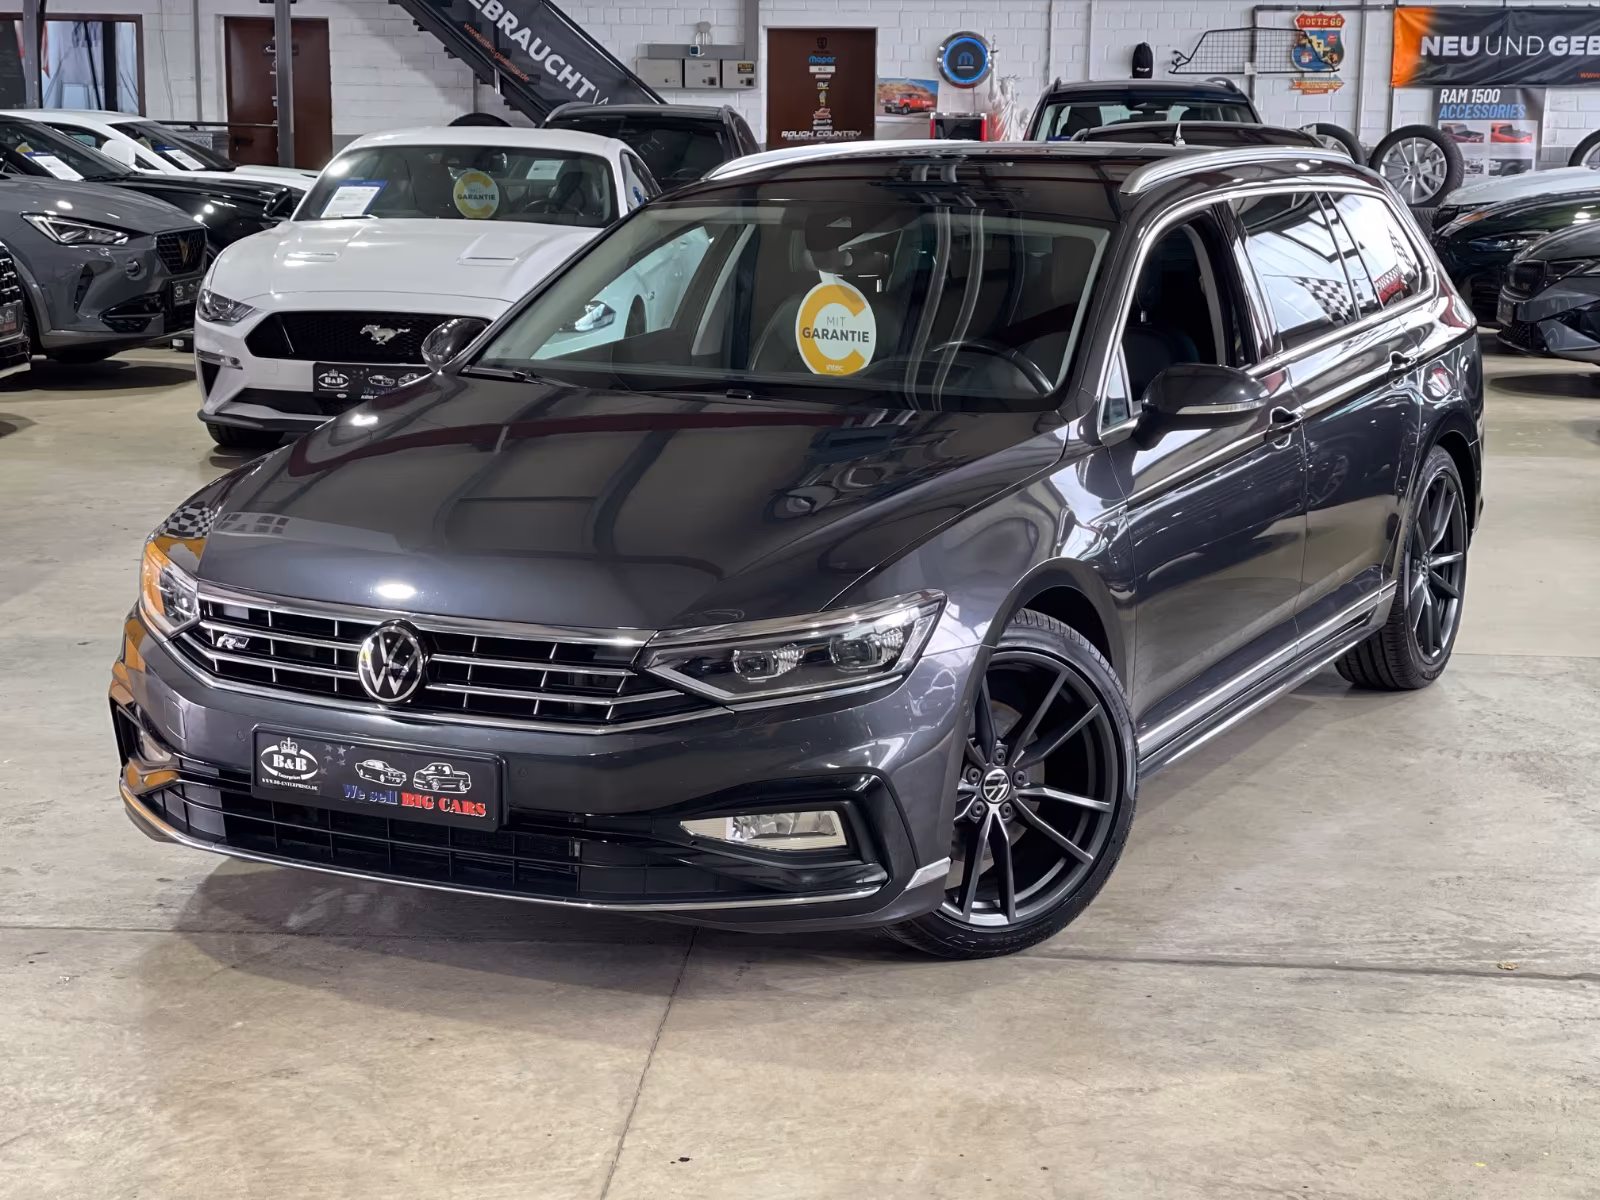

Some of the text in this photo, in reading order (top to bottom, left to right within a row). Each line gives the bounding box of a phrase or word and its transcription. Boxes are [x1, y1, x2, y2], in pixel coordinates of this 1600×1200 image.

[1420, 35, 1600, 57] NEU UND GEB
[1439, 88, 1501, 104] RAM 1500
[1438, 104, 1527, 119] ACCESSORIES
[781, 130, 862, 138] ROUGH COUNTRY
[826, 316, 846, 328] MIT
[801, 326, 870, 343] GARANTIE
[272, 753, 307, 771] B&B
[342, 783, 487, 817] We sell BIG CARS
